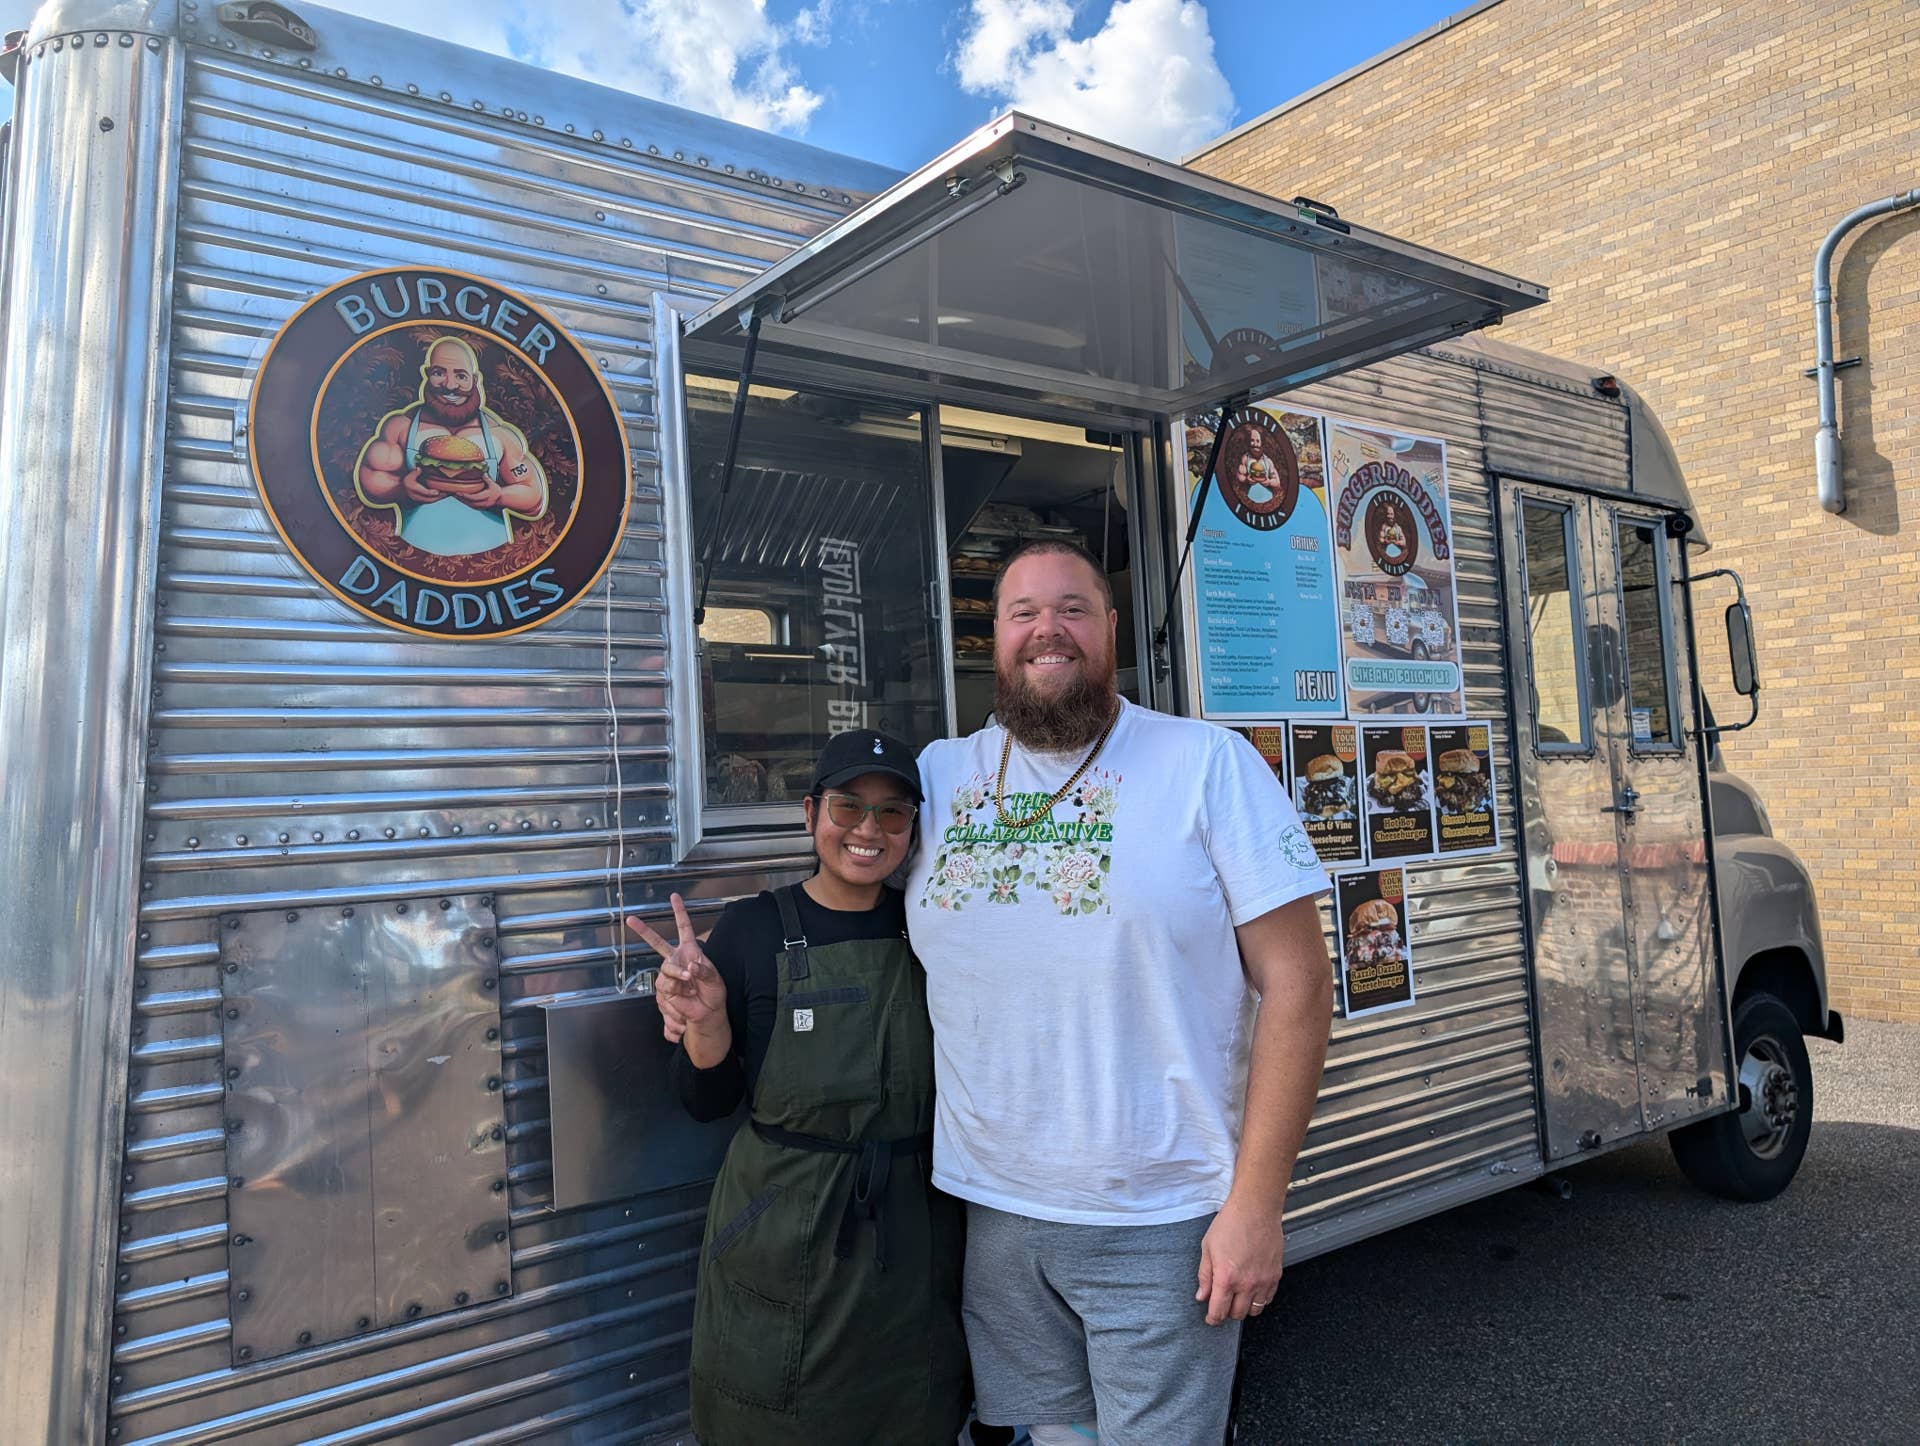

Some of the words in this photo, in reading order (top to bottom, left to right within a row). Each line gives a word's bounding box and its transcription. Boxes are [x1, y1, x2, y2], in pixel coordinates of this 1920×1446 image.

[333, 276, 558, 365] BURGER
[510, 463, 528, 478] TSC
[1290, 535, 1319, 552] DRINKS
[336, 553, 566, 629] DADDIES
[1352, 666, 1374, 682] LIKE
[1375, 667, 1394, 684] AND
[1396, 668, 1433, 685] FOLLOW
[1295, 670, 1337, 702] MENU
[1257, 735, 1281, 743] YOUR
[1335, 734, 1356, 742] YOUR
[1011, 792, 1052, 809] THE
[1305, 821, 1326, 831] Earth
[1327, 821, 1335, 830] &
[1335, 820, 1352, 830] Vine
[1384, 818, 1398, 829] Hot
[1398, 817, 1416, 829] Boy
[1442, 814, 1466, 825] Cheese
[1466, 813, 1490, 823] Please
[944, 821, 1113, 843] COLLABORATIVE
[1310, 833, 1354, 845] heeseburger
[1375, 829, 1428, 842] Cheeseburger
[1442, 826, 1490, 838] Cheeseburger
[1350, 968, 1376, 981] Razzle
[1377, 962, 1403, 976] Dazzle
[1351, 975, 1404, 994] Cheeseburger
